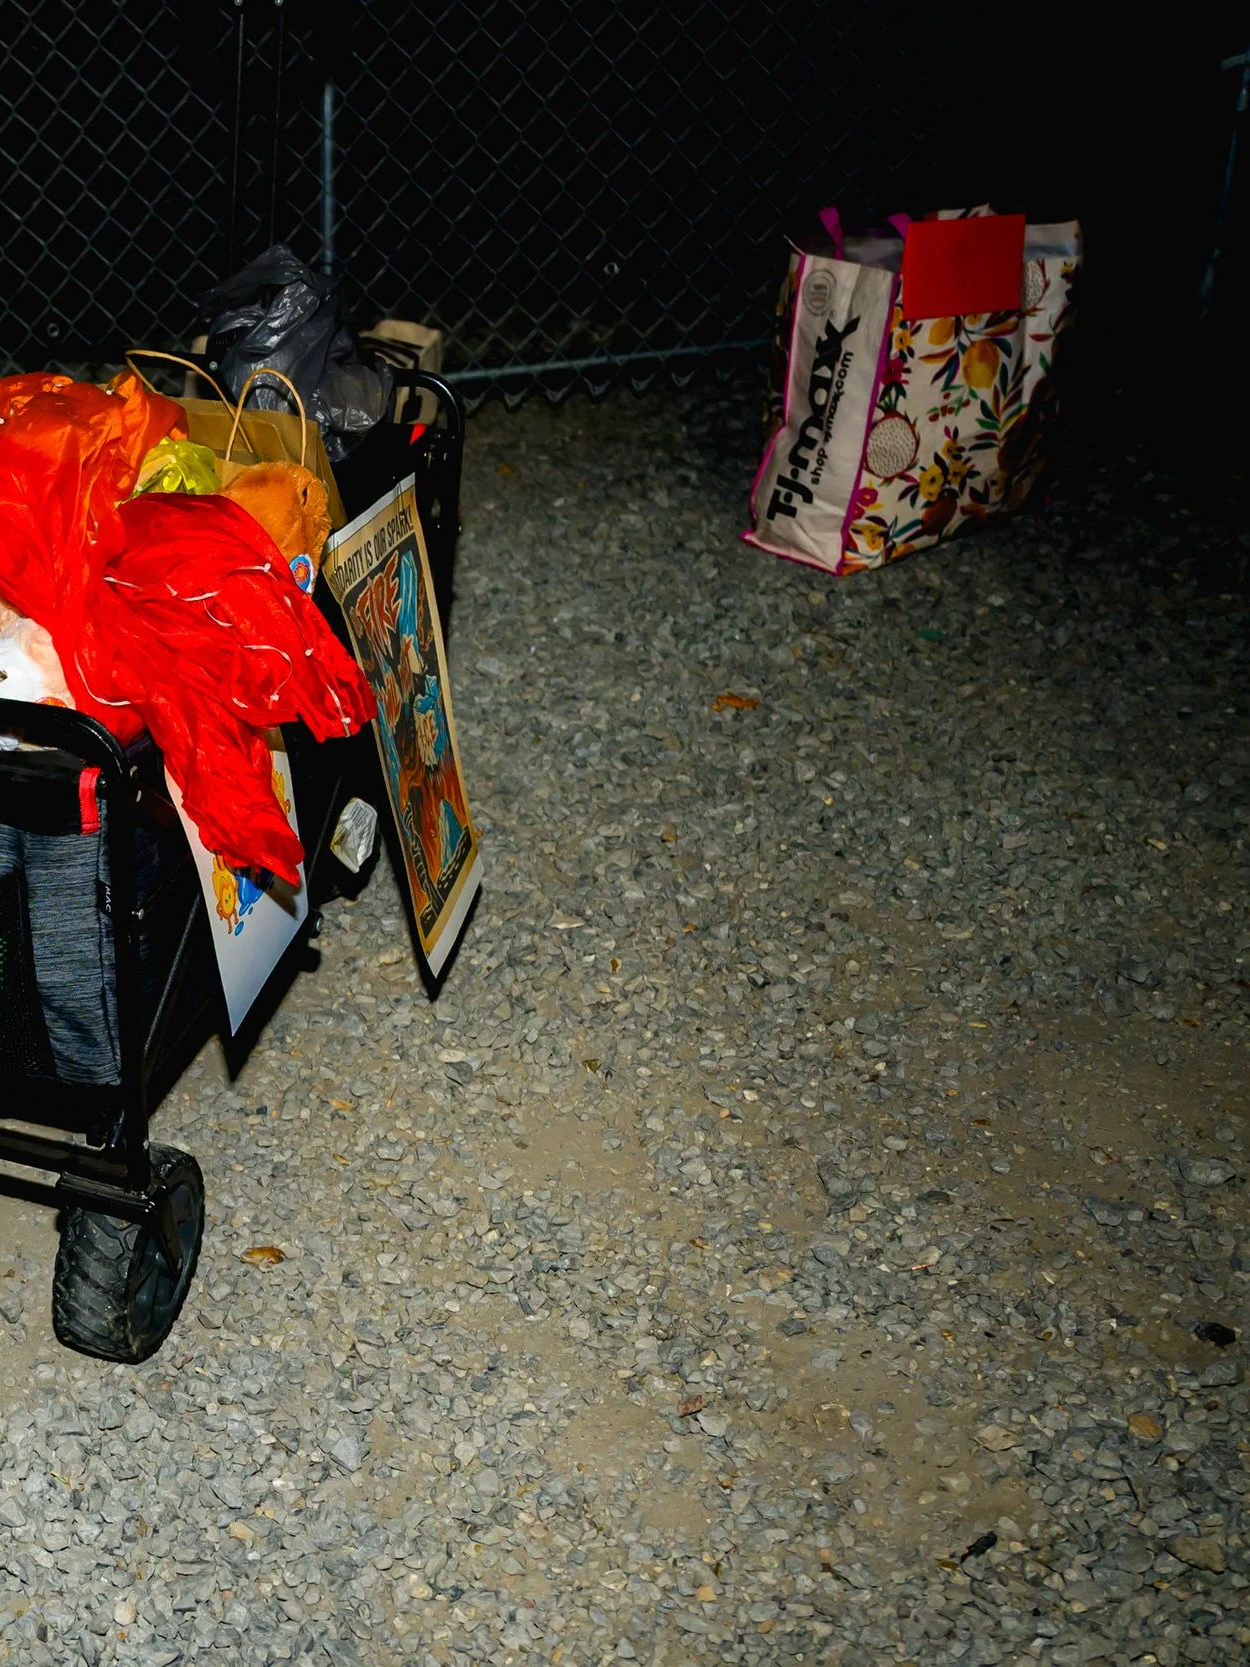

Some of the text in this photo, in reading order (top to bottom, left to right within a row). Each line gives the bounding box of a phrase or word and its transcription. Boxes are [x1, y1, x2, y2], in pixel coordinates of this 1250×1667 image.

[810, 447, 829, 485] shop
[363, 540, 374, 569] IS
[357, 553, 398, 655] FIRE
